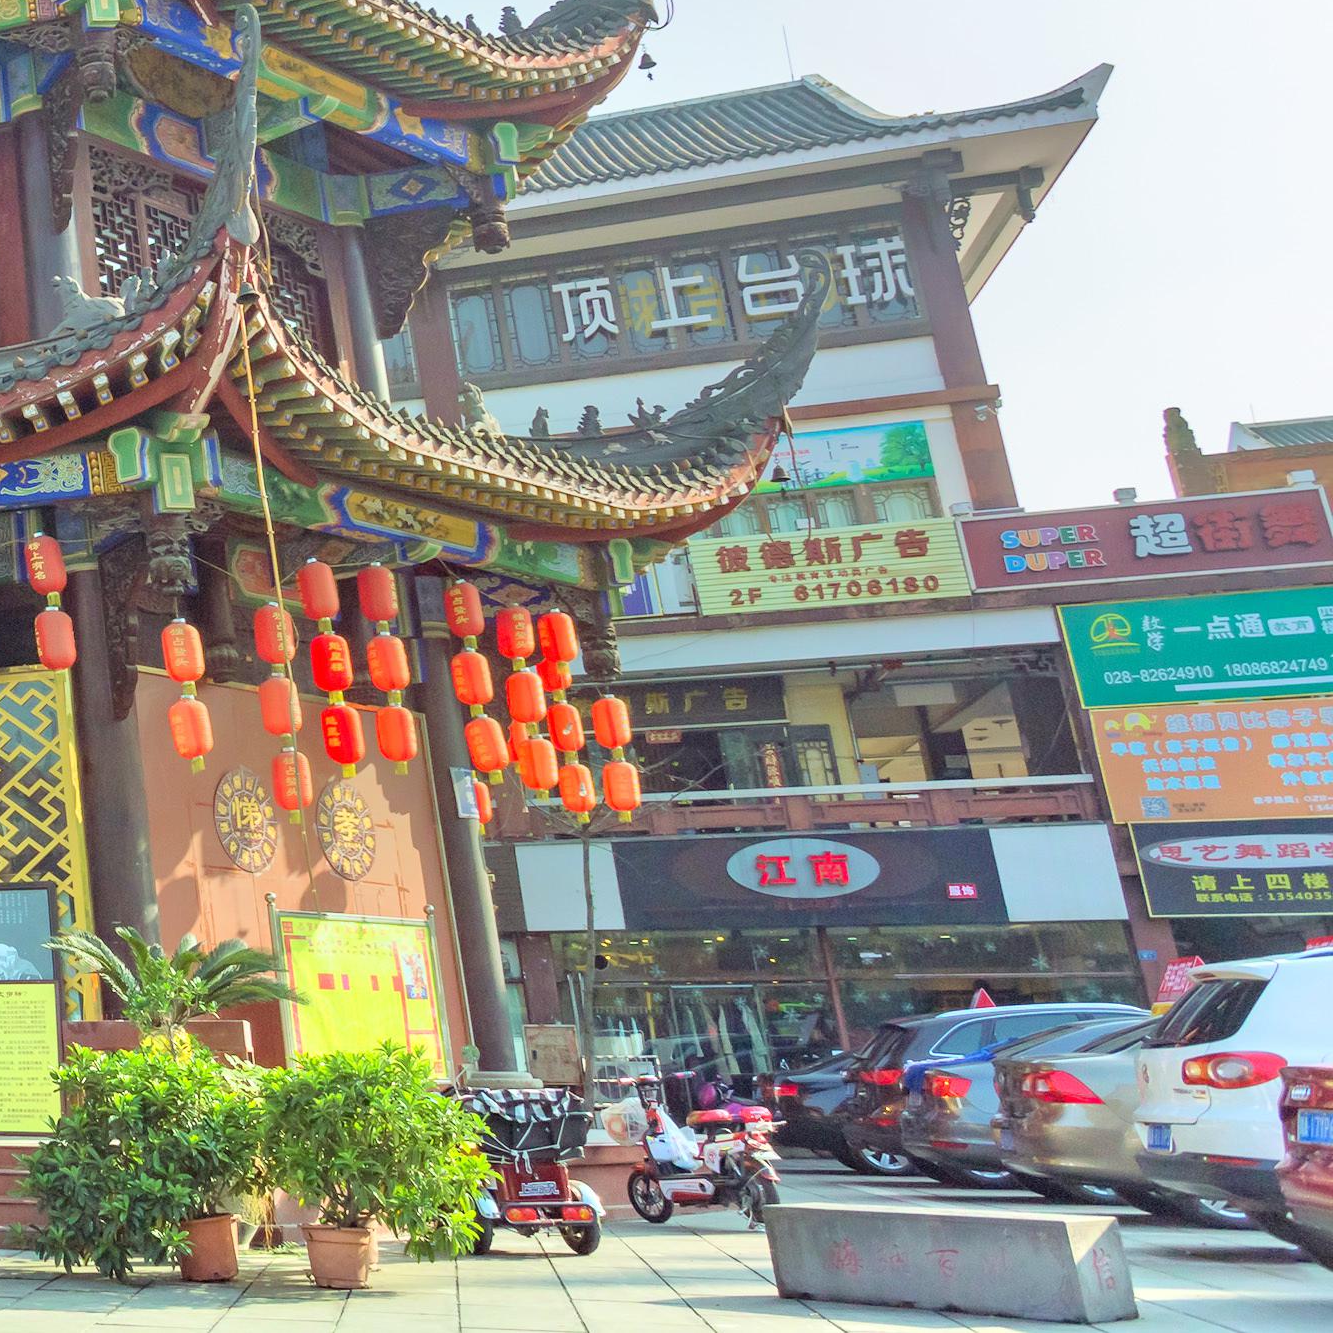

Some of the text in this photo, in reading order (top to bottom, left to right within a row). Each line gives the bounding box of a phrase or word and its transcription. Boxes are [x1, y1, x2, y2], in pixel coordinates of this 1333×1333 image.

[552, 236, 915, 342] 顶上台球
[999, 524, 1099, 549] SUPER
[1128, 504, 1320, 558] 超街舞
[1003, 548, 1107, 574] DUPER
[729, 587, 762, 606] 2F
[1173, 613, 1267, 641] 一点通
[1103, 657, 1328, 685] 028-82624910 18086824749
[621, 686, 748, 715] 斯广告
[334, 807, 360, 841] 孝
[755, 850, 851, 887] 江南
[1191, 872, 1330, 891] 请上四楼
